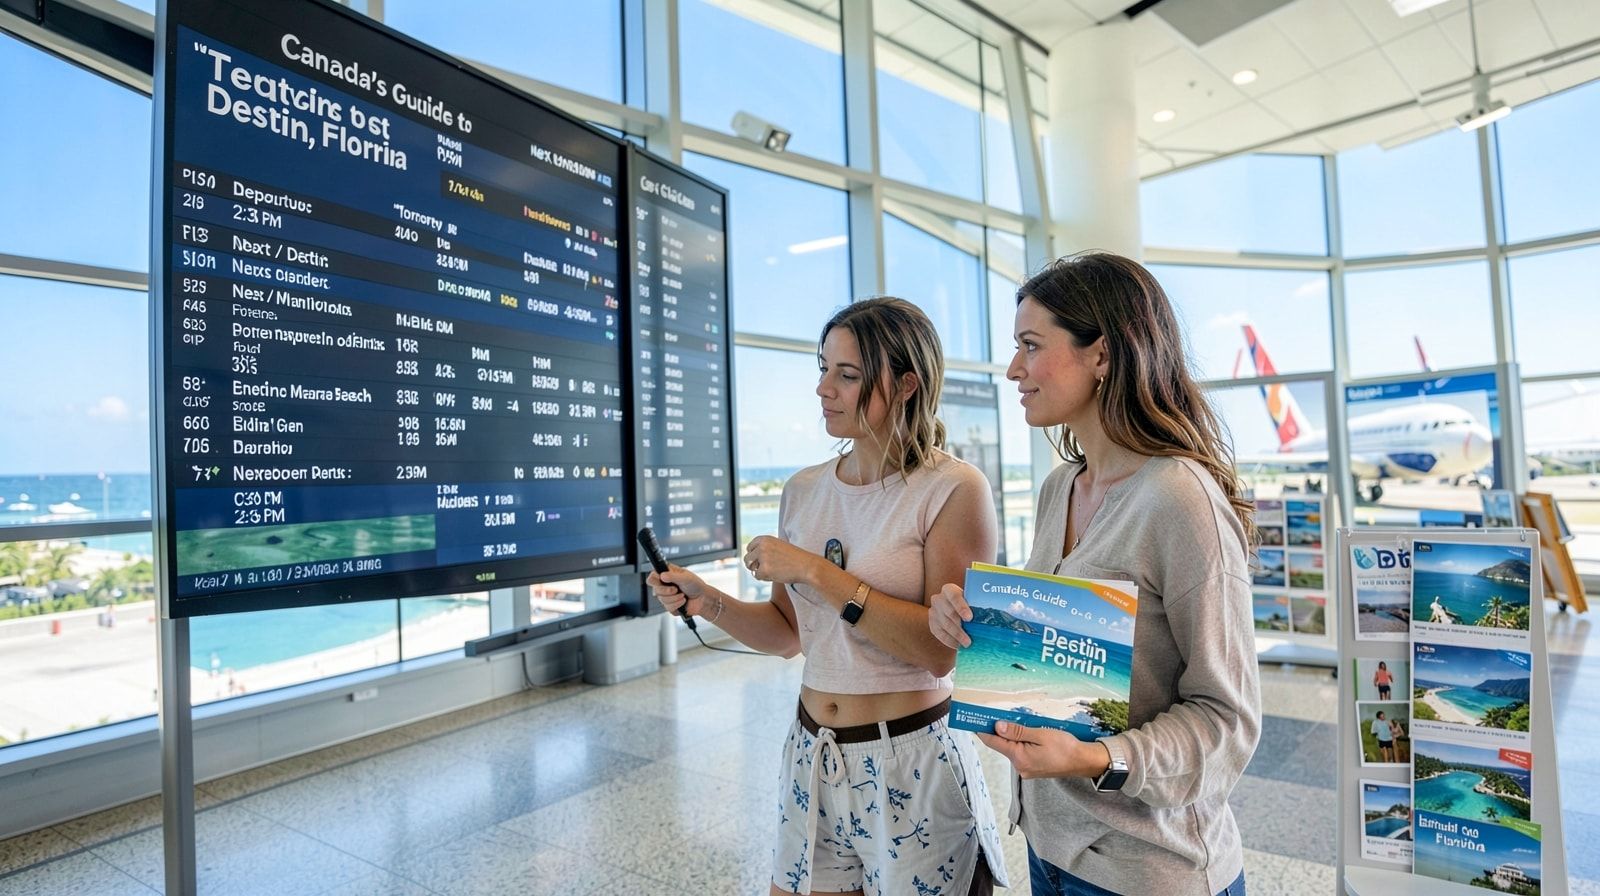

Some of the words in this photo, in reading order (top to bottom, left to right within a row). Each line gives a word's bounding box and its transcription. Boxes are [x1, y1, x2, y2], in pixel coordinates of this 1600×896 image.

[281, 33, 388, 97] Canada's
[457, 112, 472, 133] to
[262, 211, 282, 229] PM
[263, 507, 286, 523] PM
